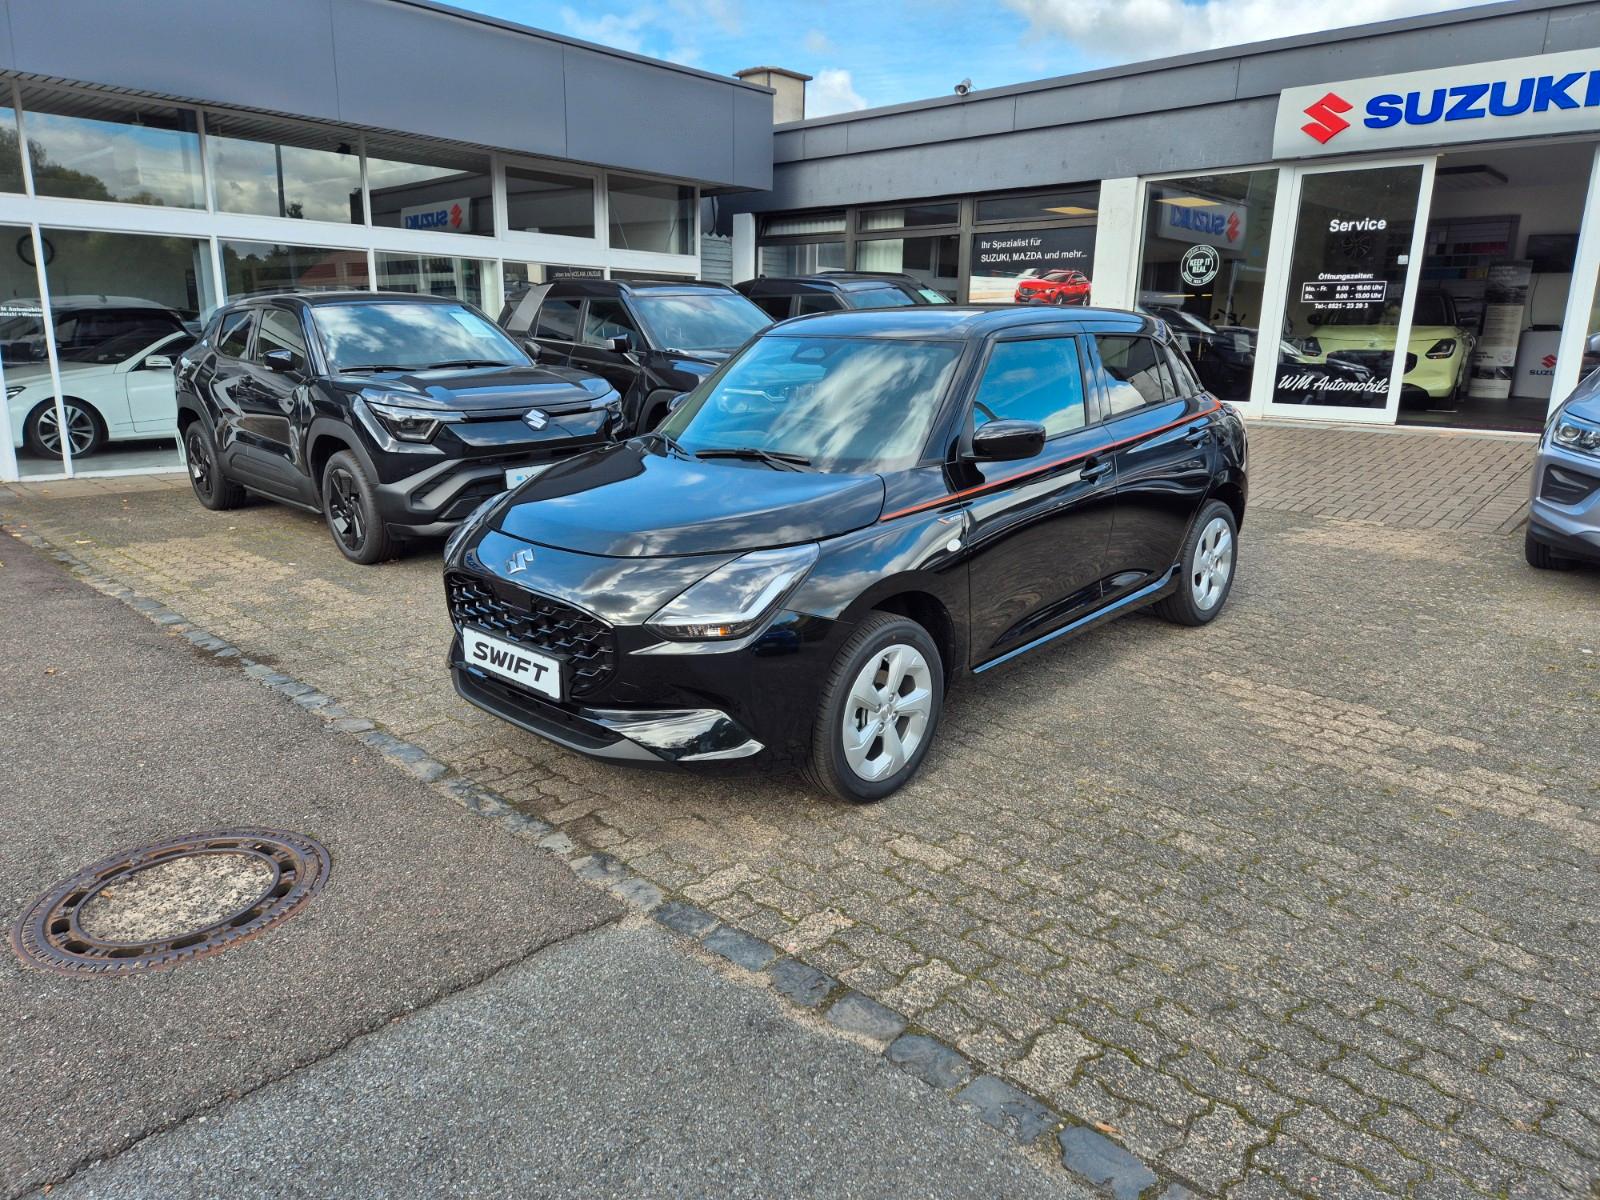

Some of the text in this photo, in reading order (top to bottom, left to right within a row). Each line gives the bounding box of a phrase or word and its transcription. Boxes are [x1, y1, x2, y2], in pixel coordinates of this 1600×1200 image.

[1364, 71, 1600, 129] SUZUKI
[1329, 217, 1387, 232] Service
[981, 237, 1041, 249] Ihr Spezialist für
[981, 253, 1011, 262] SUZUKI,
[1013, 251, 1042, 261] MAZDA
[1044, 250, 1059, 259] und
[1204, 257, 1211, 265] IT
[1192, 265, 1207, 273] REAL
[1318, 272, 1374, 281] Öffnungszeiten:
[1278, 374, 1389, 394] WM Automobile
[472, 641, 549, 682] SWIFT
